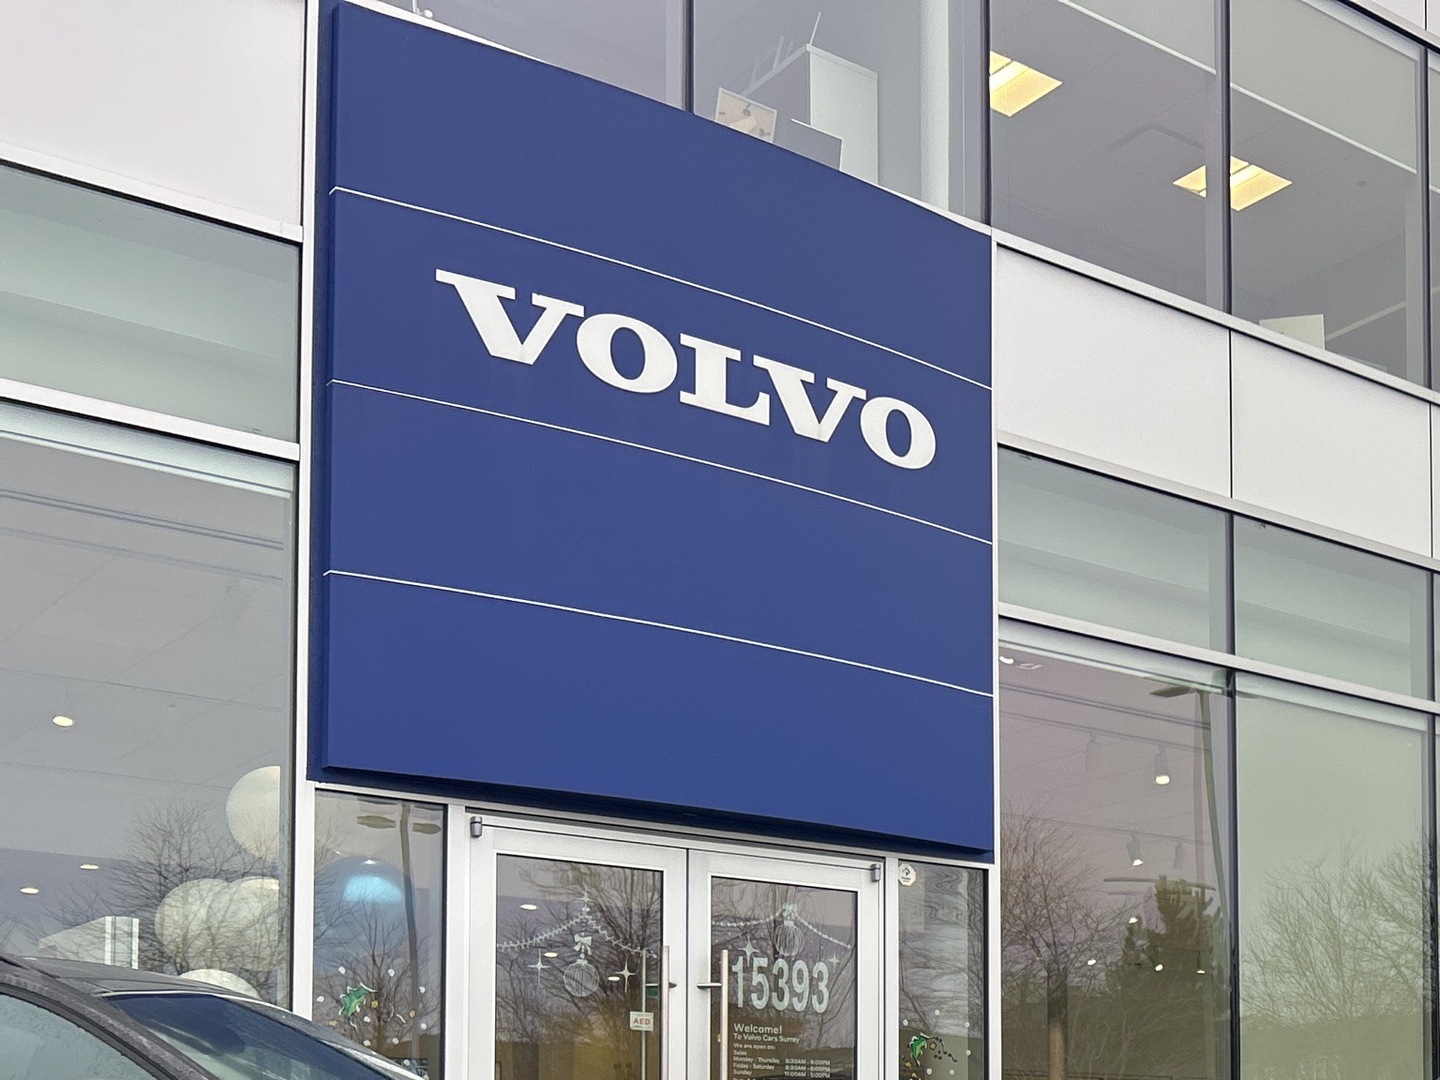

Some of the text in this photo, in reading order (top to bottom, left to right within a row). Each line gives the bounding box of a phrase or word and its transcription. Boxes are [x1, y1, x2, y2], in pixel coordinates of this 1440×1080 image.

[435, 268, 936, 470] VOLVO
[731, 955, 829, 1014] 15393
[633, 1016, 651, 1026] AED
[733, 1023, 783, 1035] Welcome!
[779, 1036, 800, 1044] Surrey
